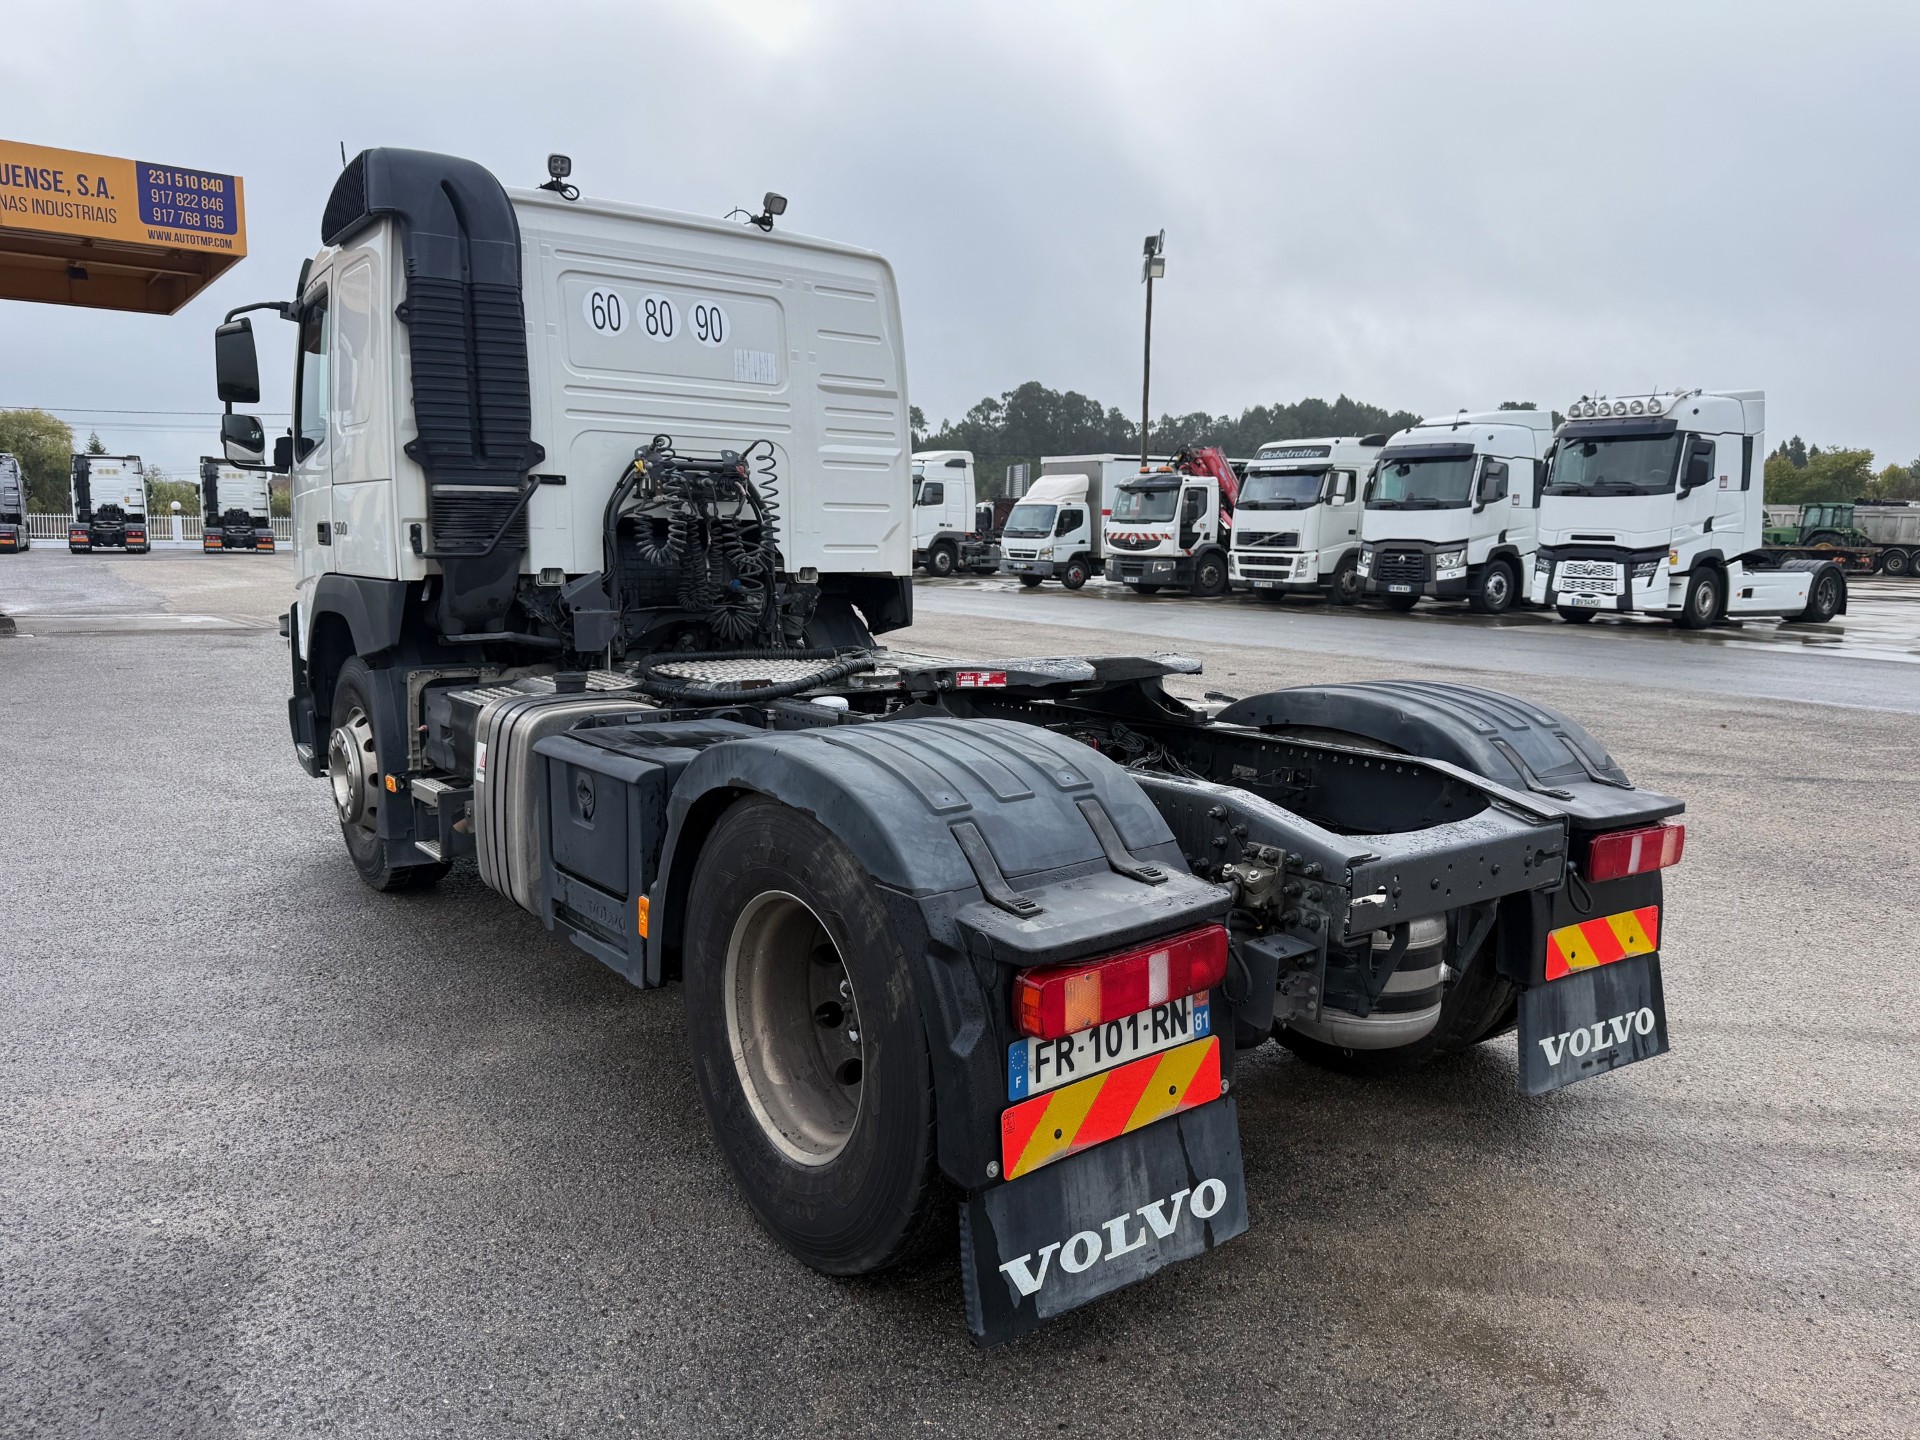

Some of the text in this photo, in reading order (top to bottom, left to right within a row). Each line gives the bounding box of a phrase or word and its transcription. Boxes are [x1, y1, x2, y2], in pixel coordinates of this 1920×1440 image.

[76, 173, 115, 200] S.A.
[149, 169, 224, 193] 231 510 840
[32, 198, 117, 224] INDUSTRIAIS
[151, 189, 224, 212] 917 822 846
[153, 207, 225, 230] 917 768 195
[147, 229, 233, 250] WWW.AUTOTMP.COM
[591, 291, 621, 332] 60
[645, 298, 673, 338] 80
[695, 304, 723, 343] 90
[1259, 449, 1323, 460] Globetrotter
[1195, 1010, 1209, 1031] 81
[1035, 999, 1188, 1084] FR-101-RN
[1538, 1006, 1655, 1066] VOLVO
[1015, 1076, 1022, 1089] F
[998, 1177, 1227, 1297] VOLVO
